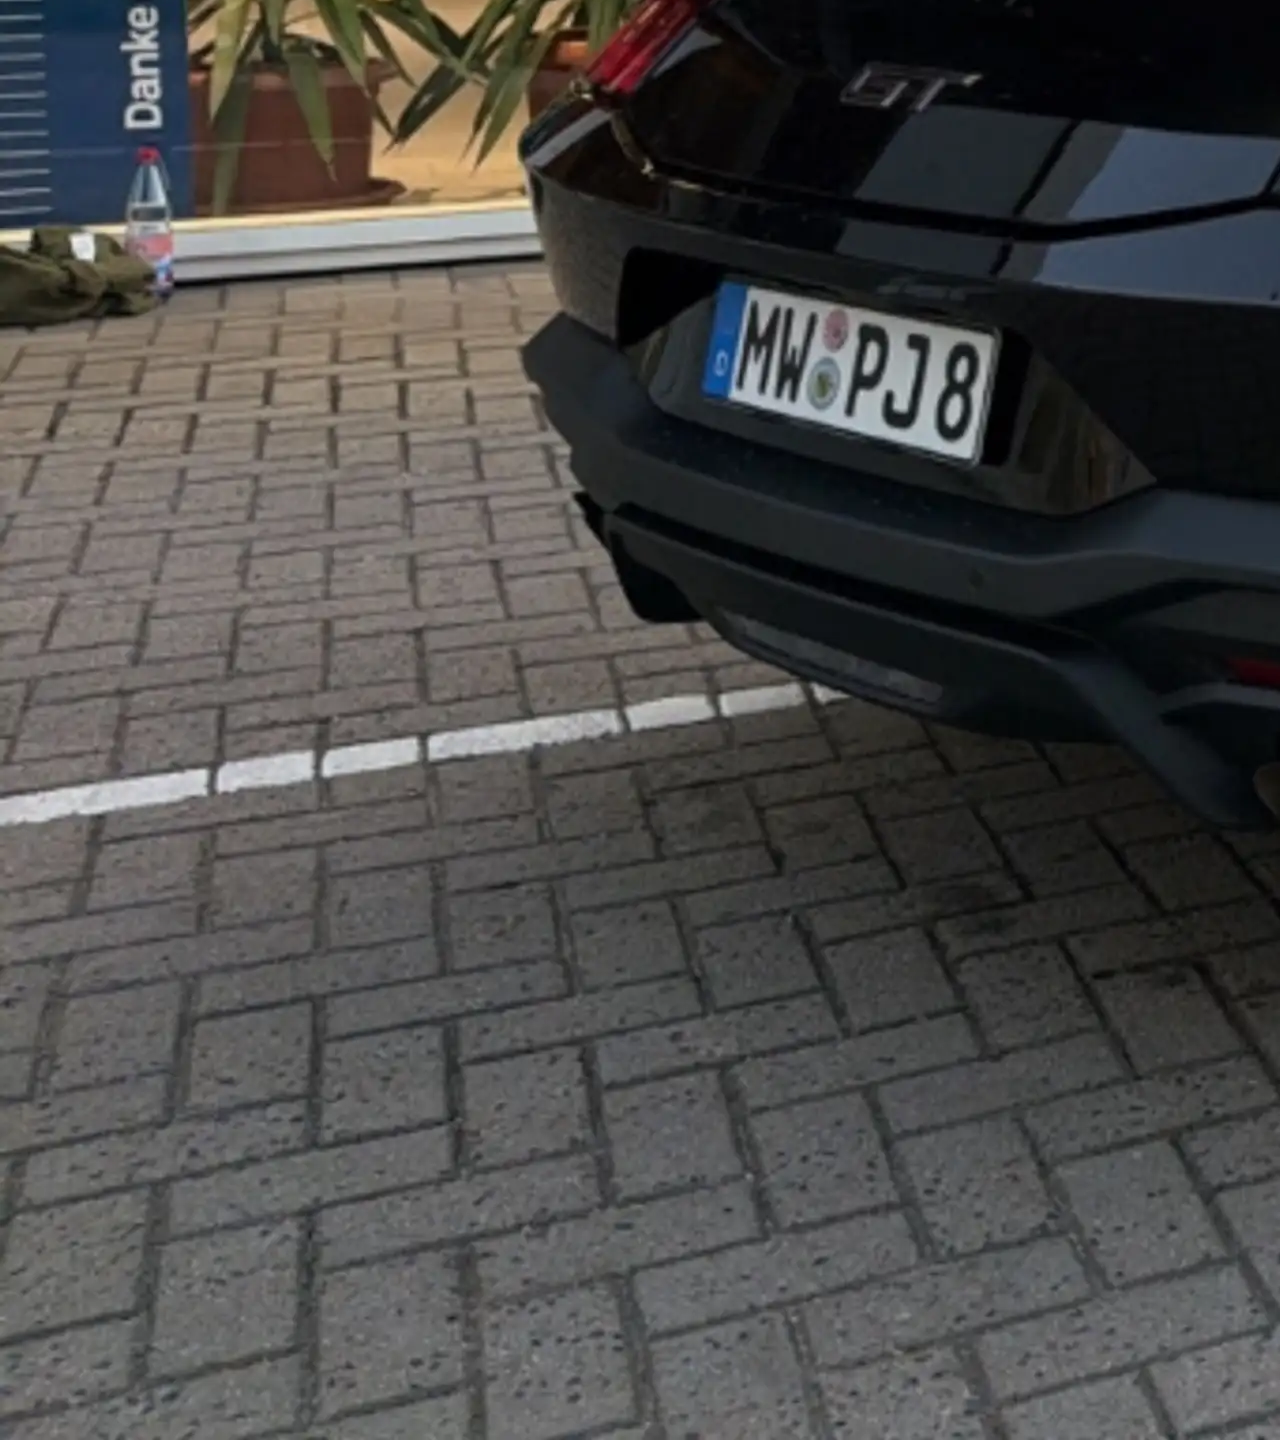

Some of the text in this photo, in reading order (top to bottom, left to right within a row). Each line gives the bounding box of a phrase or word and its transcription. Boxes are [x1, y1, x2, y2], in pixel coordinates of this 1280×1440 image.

[119, 6, 163, 129] Danke
[840, 61, 983, 112] GT
[735, 300, 819, 404] MW
